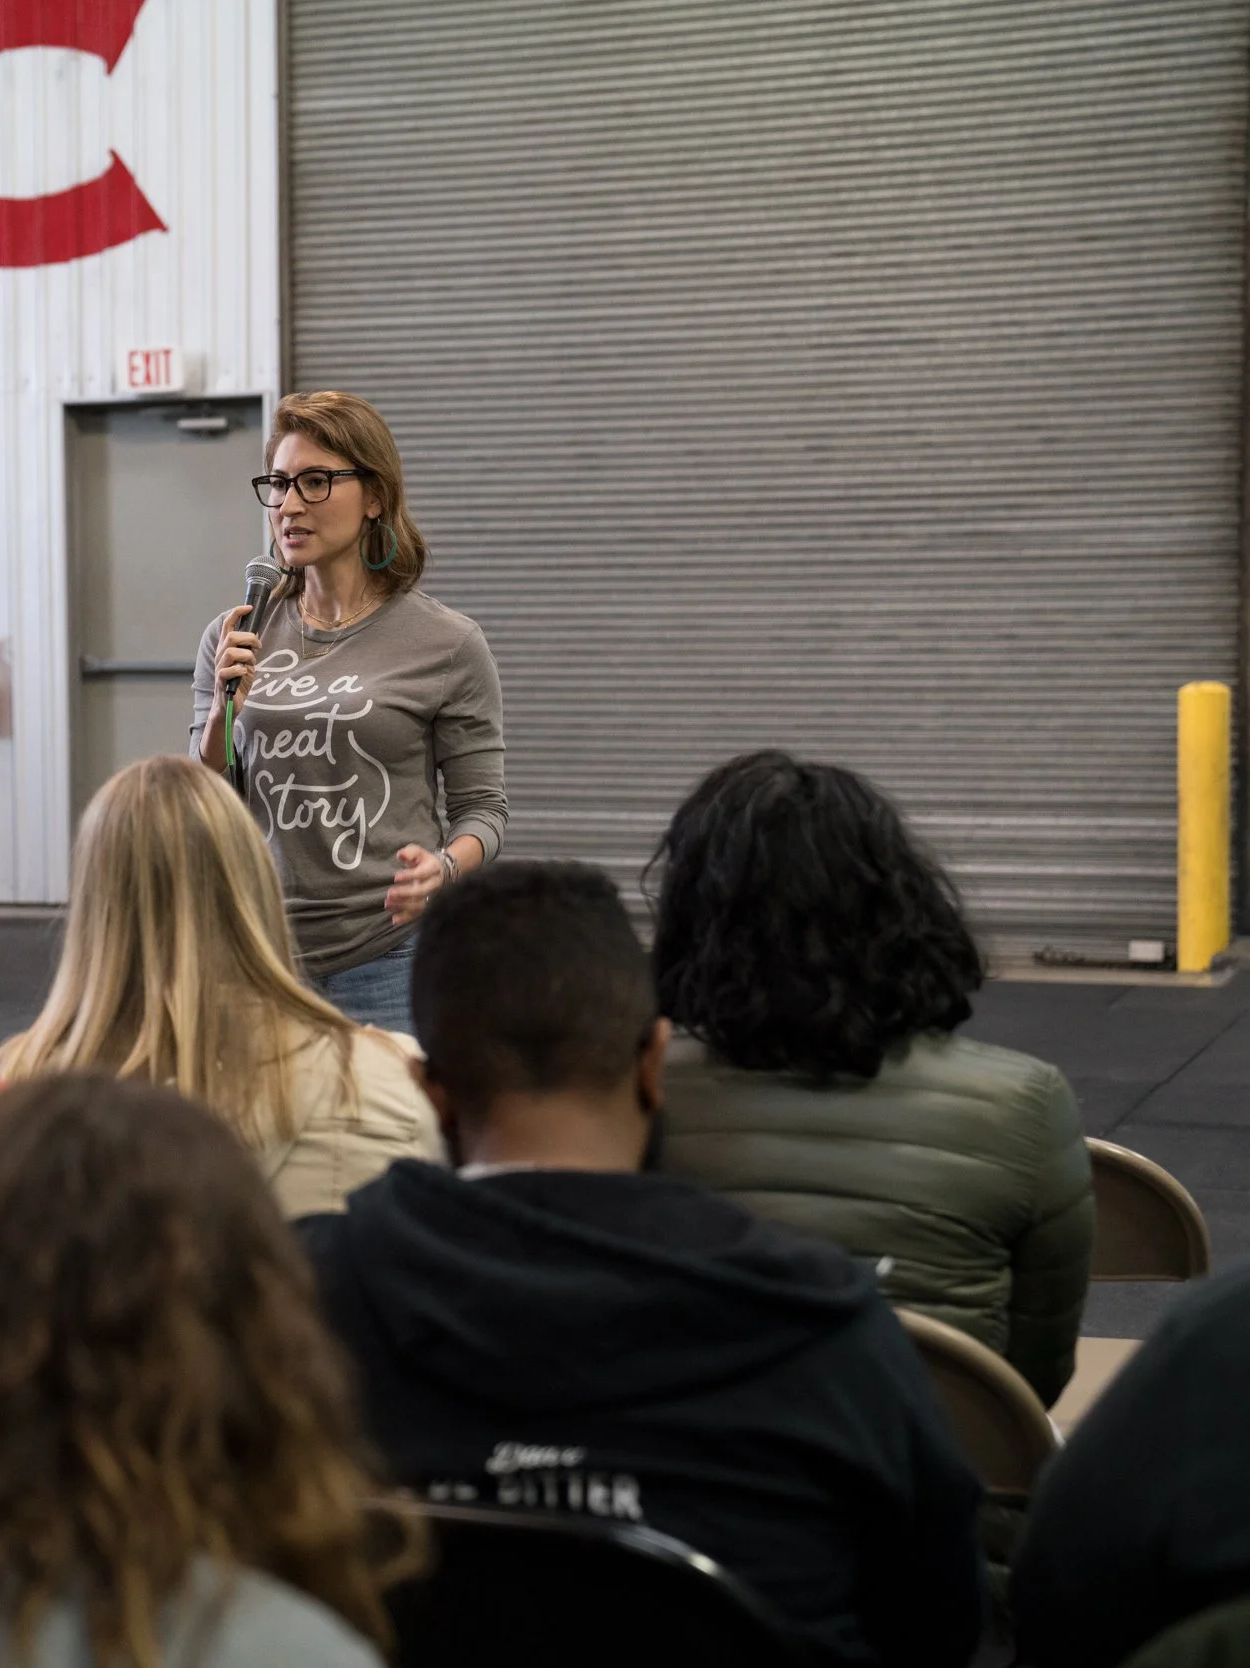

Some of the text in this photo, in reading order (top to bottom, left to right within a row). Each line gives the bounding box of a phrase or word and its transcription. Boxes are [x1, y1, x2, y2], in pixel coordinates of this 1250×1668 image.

[128, 348, 173, 387] EXIT
[327, 674, 364, 694] a
[254, 770, 368, 870] Story
